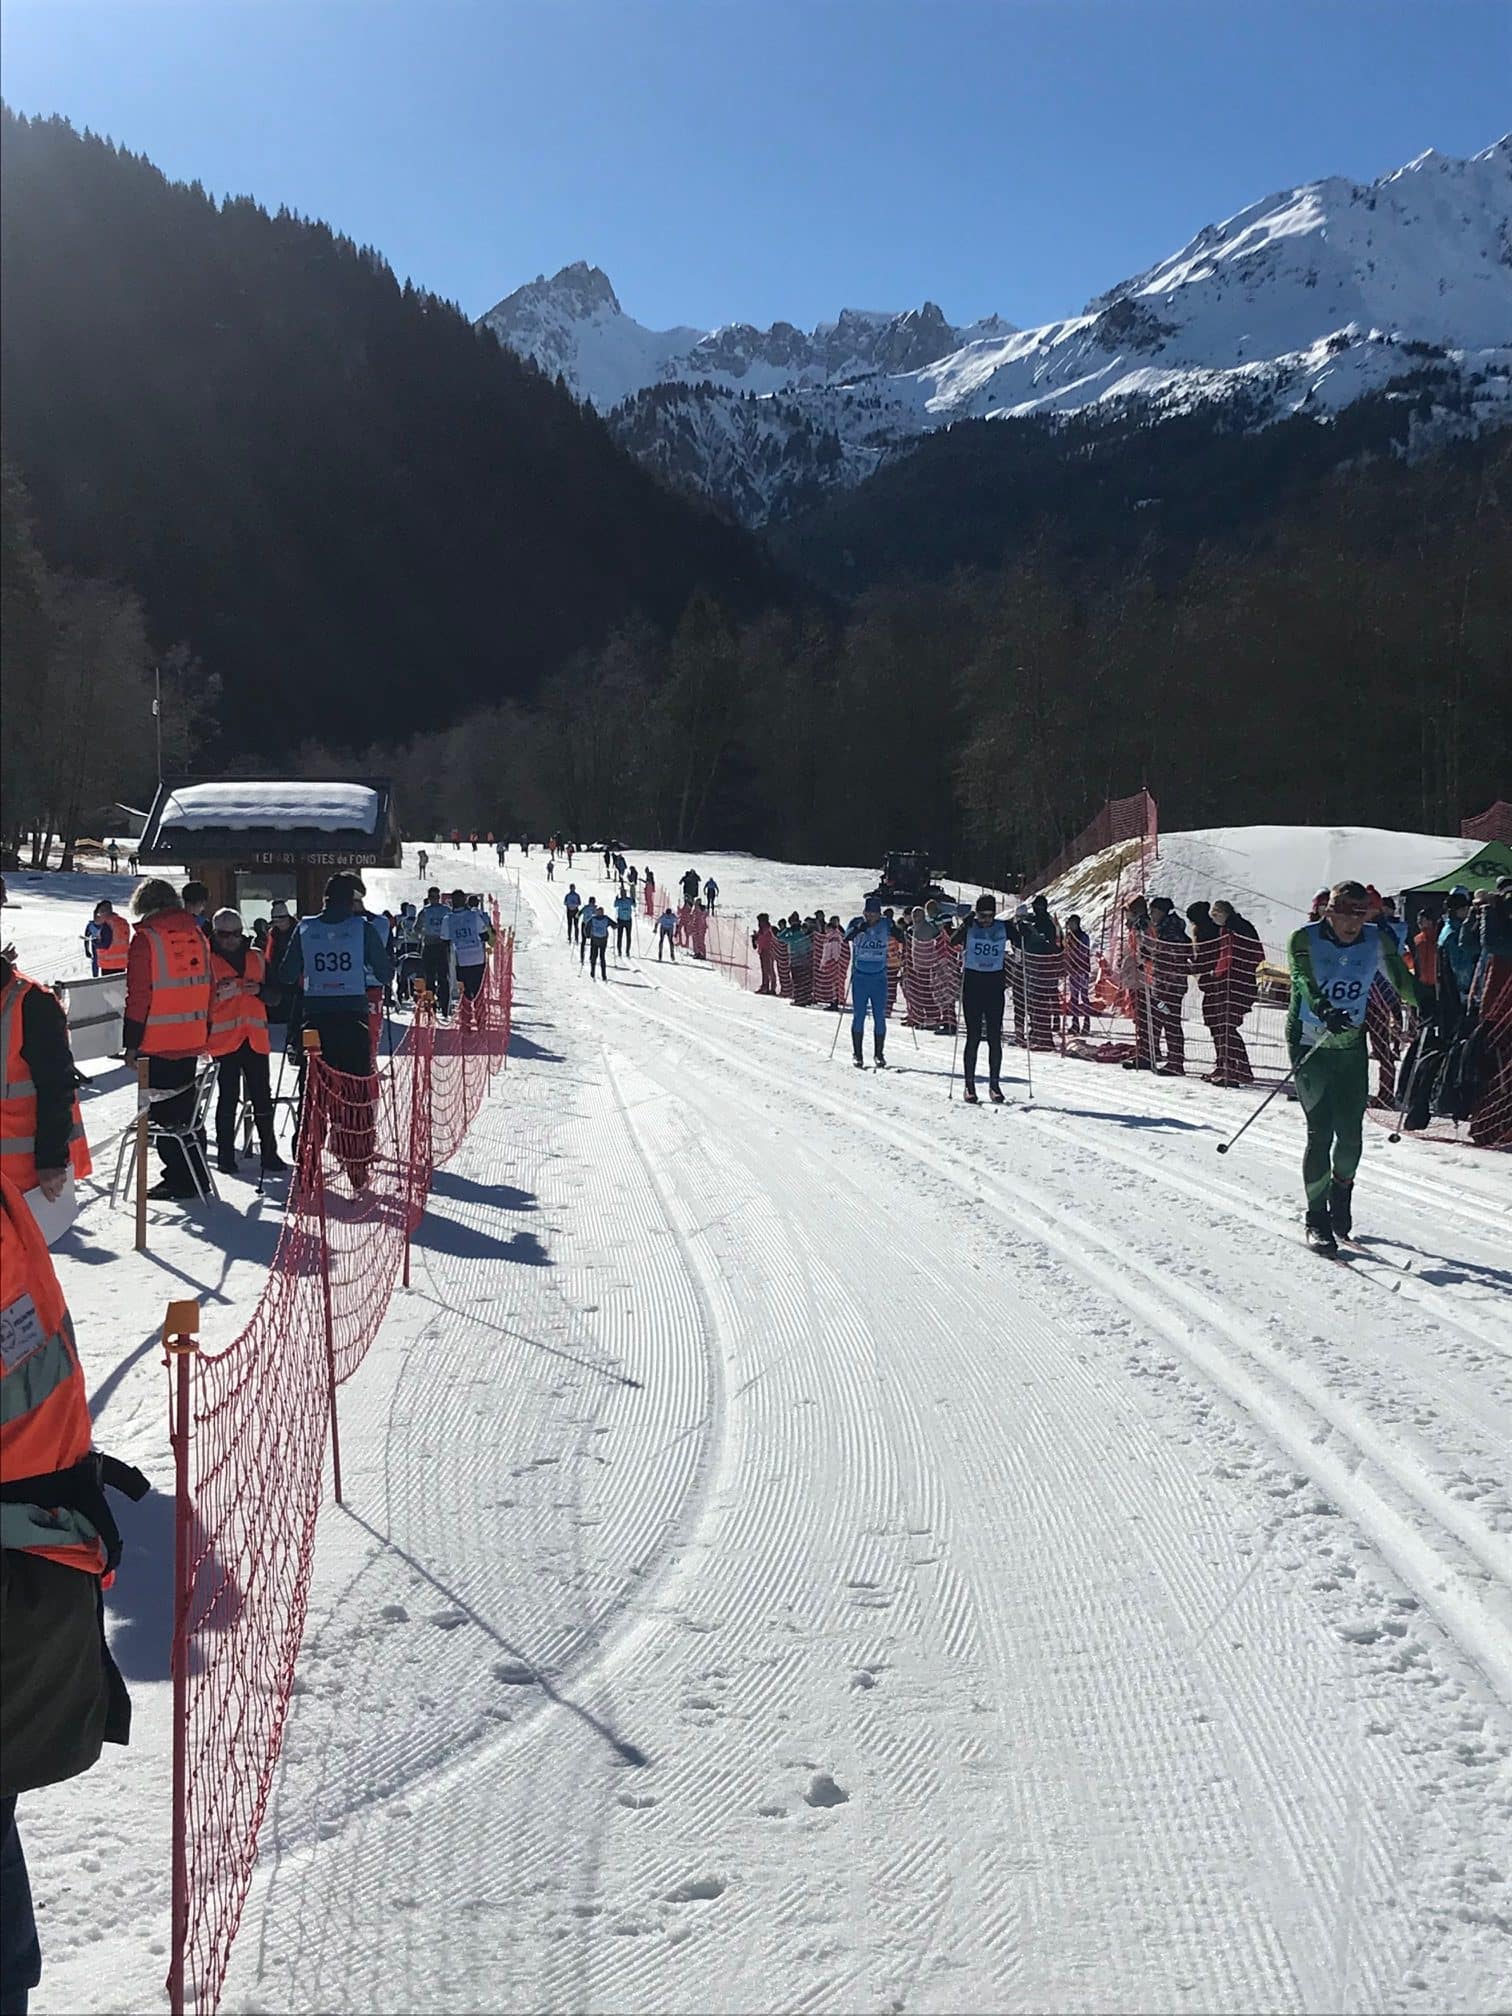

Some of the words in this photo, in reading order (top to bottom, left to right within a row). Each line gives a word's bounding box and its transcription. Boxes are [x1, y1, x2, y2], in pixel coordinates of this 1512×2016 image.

[349, 853, 377, 865] FOND
[314, 951, 352, 972] 638
[1319, 979, 1363, 1000] 468
